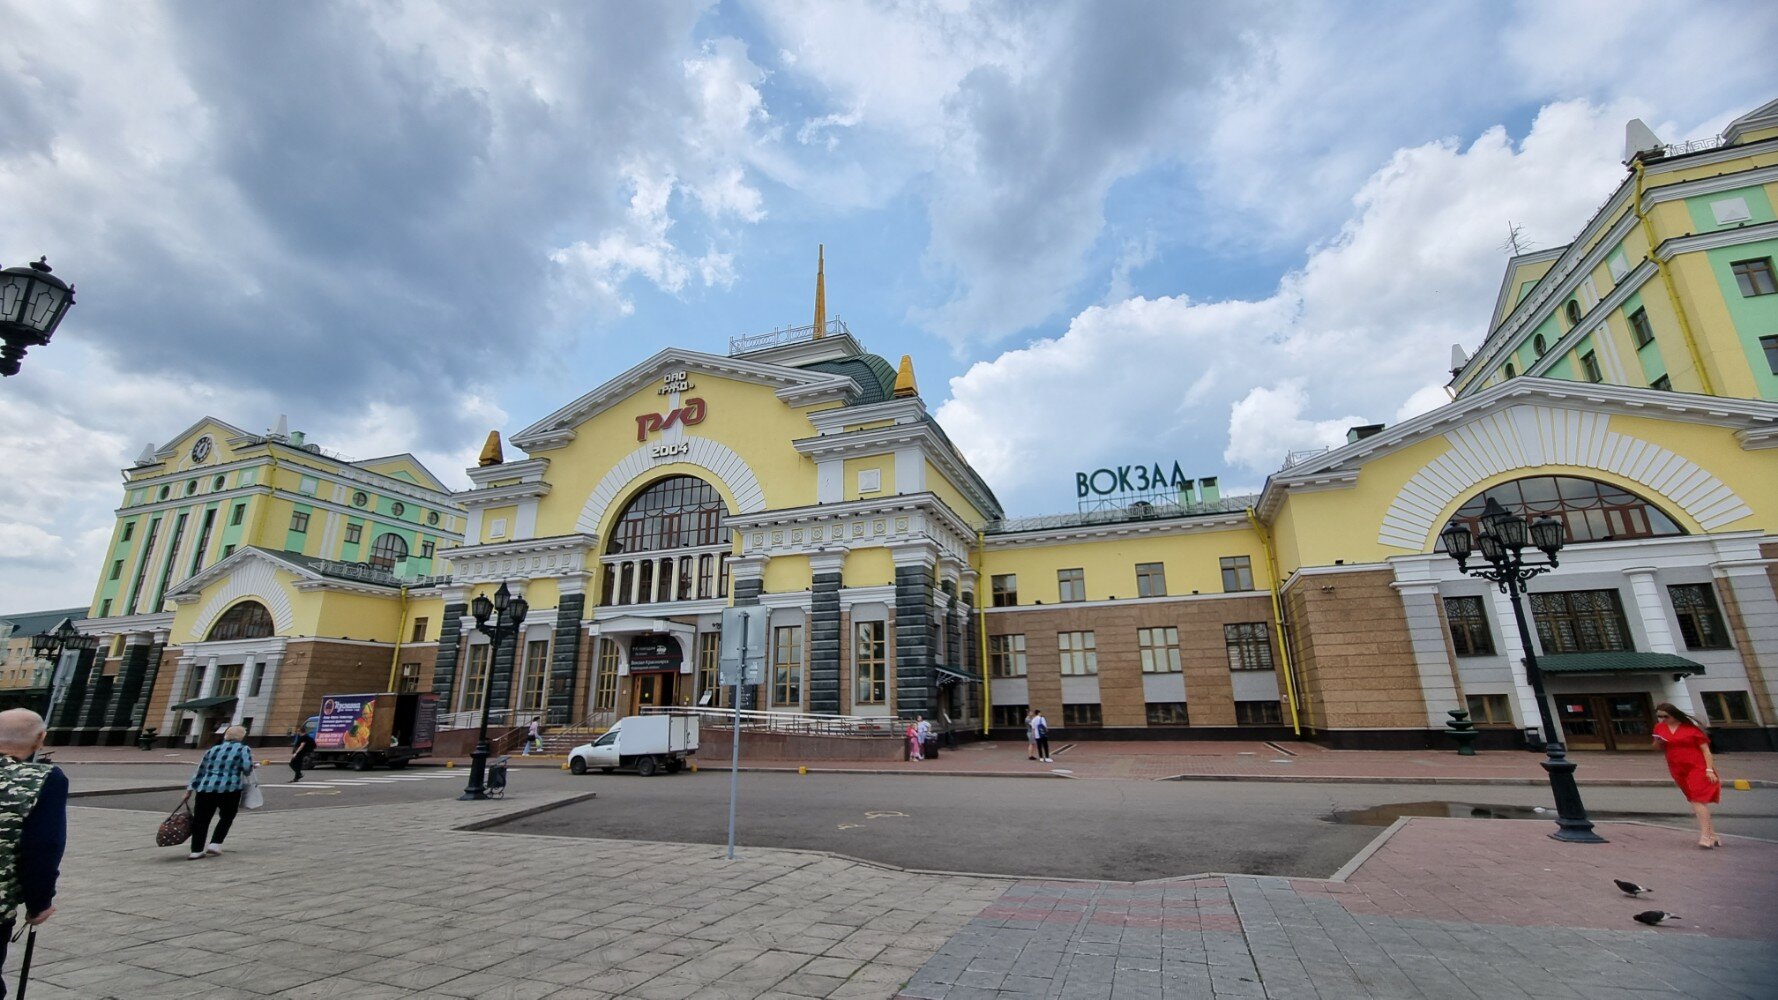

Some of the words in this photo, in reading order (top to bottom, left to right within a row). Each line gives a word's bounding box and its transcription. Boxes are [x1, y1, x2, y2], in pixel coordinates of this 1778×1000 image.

[664, 371, 687, 383] ОАО
[651, 442, 689, 458] 2004
[1076, 459, 1188, 498] ВОКЗАЛ
